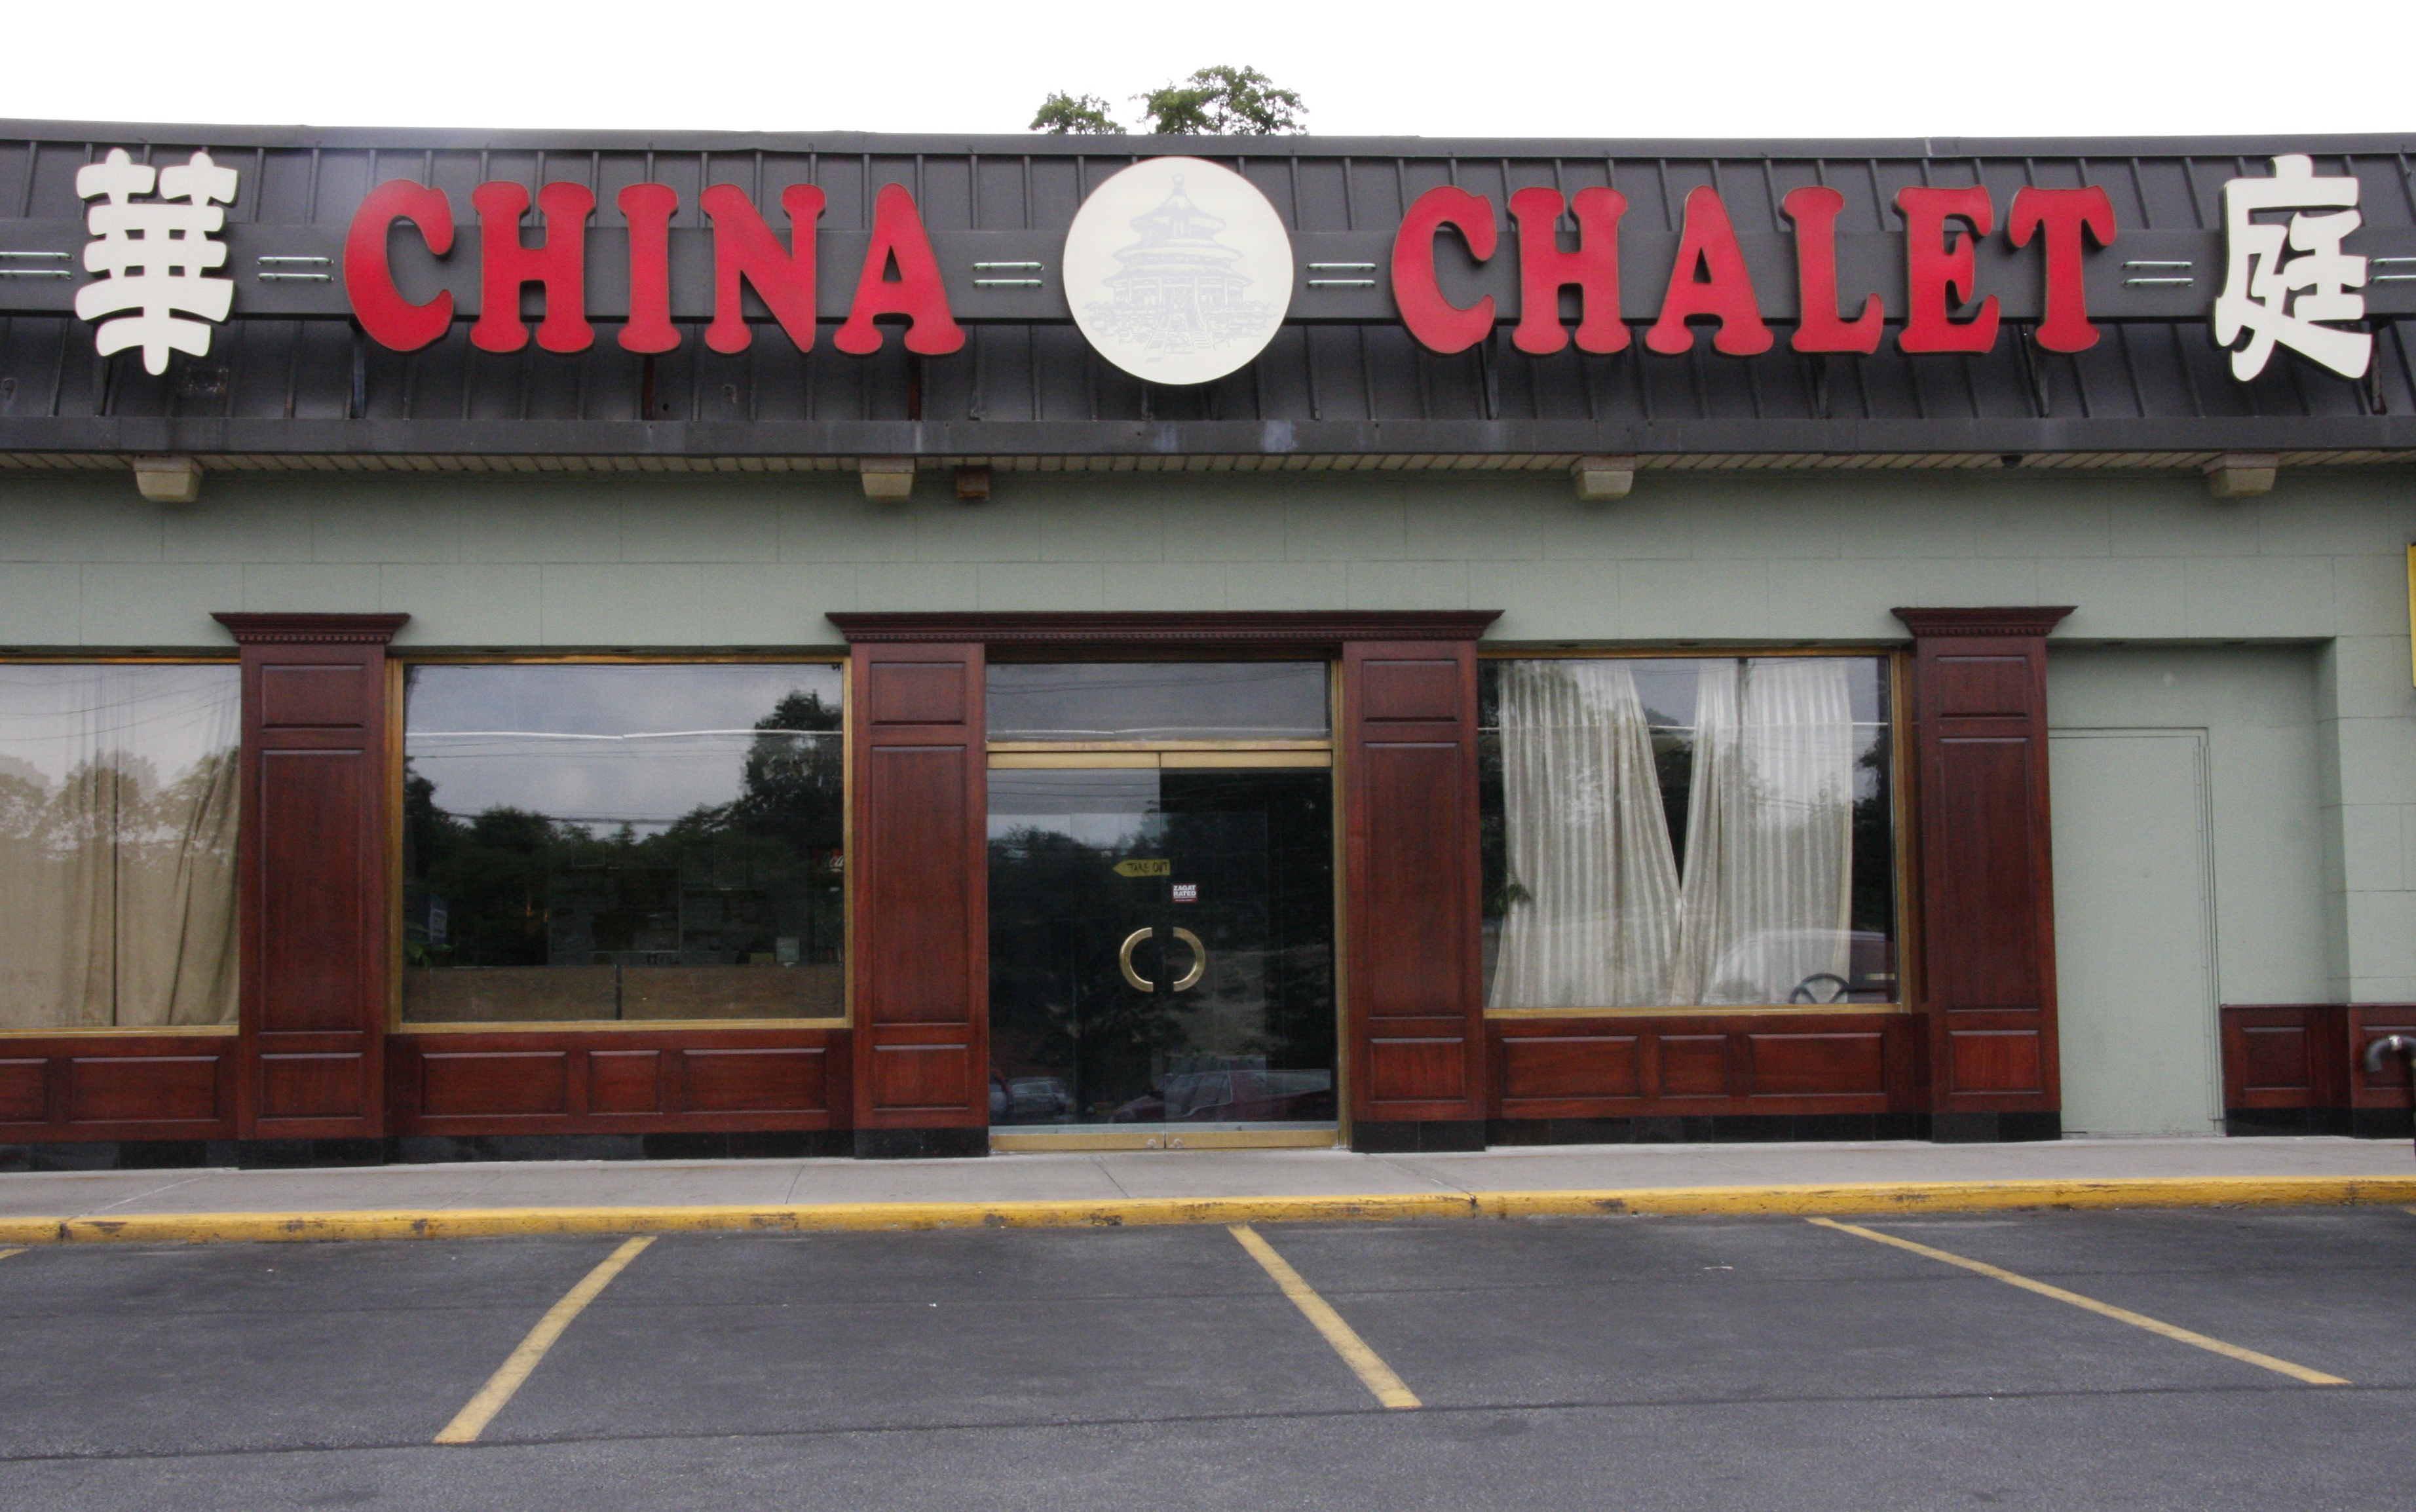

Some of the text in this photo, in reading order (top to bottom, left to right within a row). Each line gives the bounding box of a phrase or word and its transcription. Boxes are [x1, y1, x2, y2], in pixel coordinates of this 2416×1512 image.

[75, 148, 238, 376] 華
[343, 179, 2117, 356] CHINA CHALET
[2213, 154, 2373, 382] 庭
[1127, 861, 1168, 875] TAKE OUT
